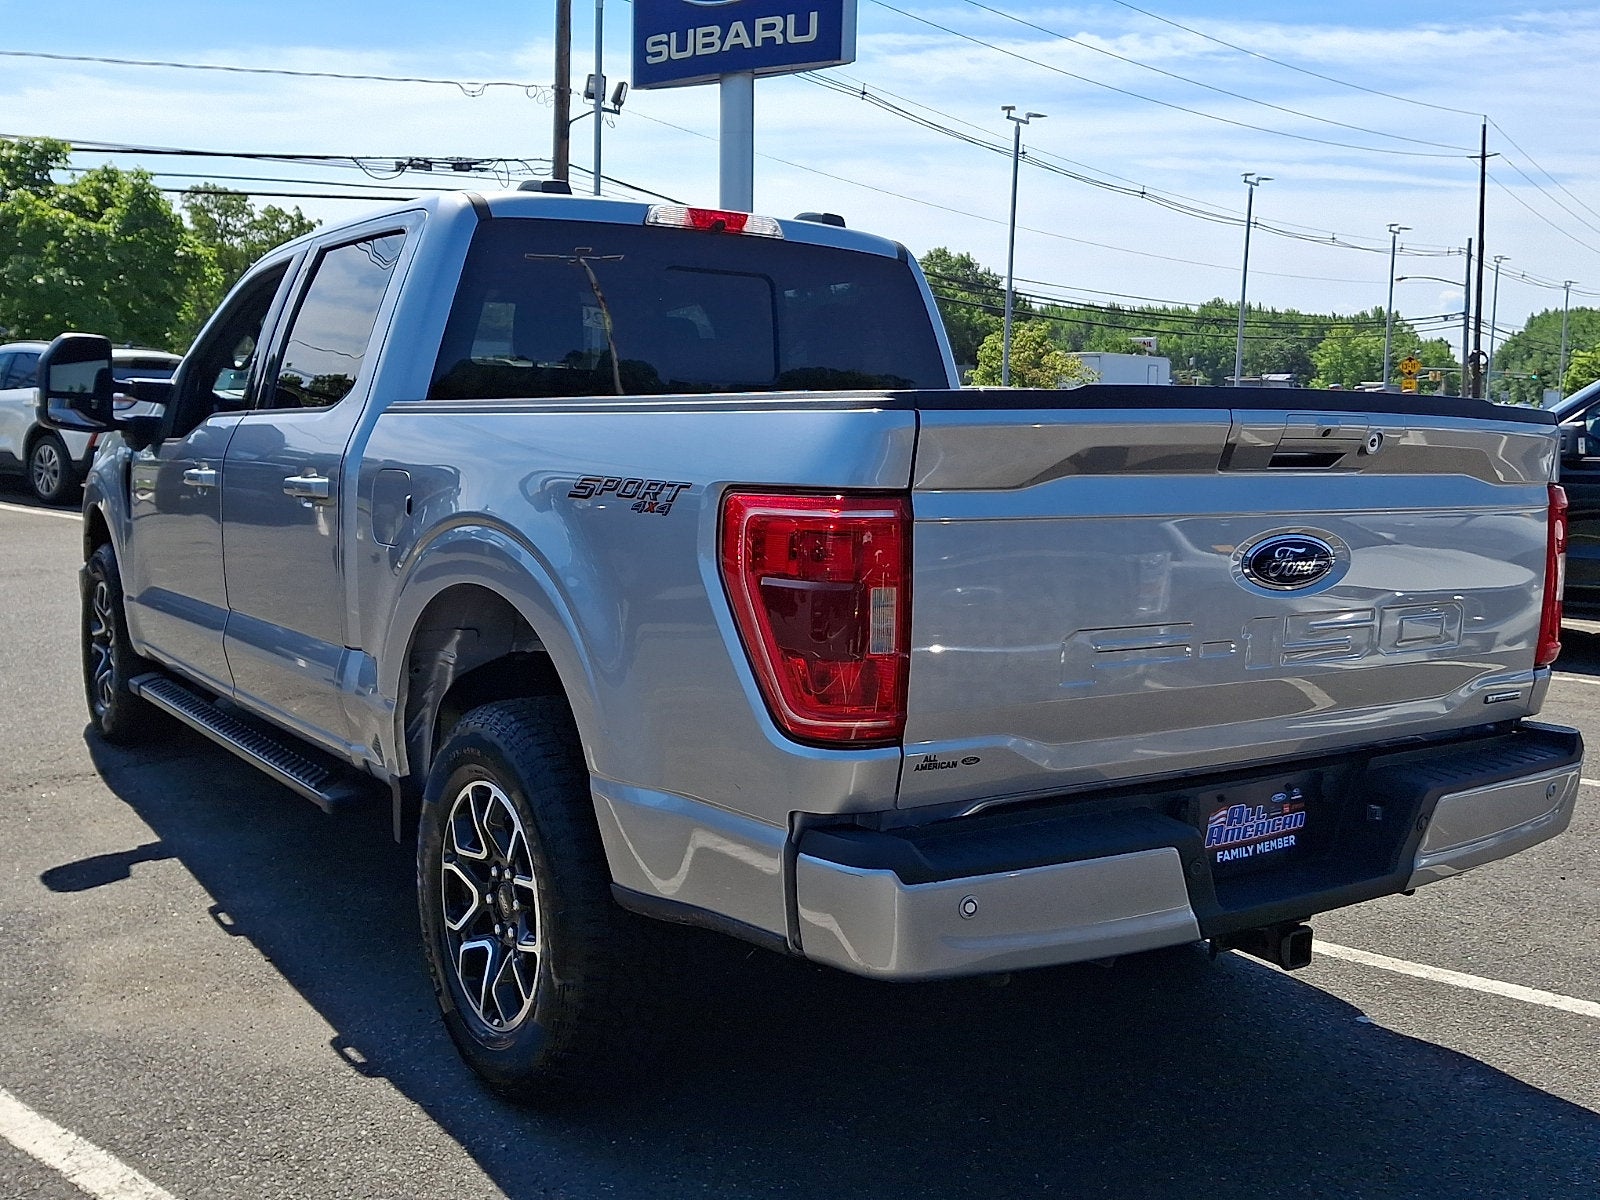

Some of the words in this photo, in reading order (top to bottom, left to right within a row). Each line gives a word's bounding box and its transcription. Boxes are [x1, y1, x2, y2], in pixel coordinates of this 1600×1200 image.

[645, 11, 818, 64] SUBARU
[568, 475, 692, 502] SPORT
[1269, 547, 1317, 577] Ford
[1059, 601, 1464, 688] F-150
[914, 761, 957, 771] AMERICAN
[923, 755, 938, 763] ALL
[1217, 845, 1255, 863] FAMILY
[1256, 835, 1296, 855] MEMBER
